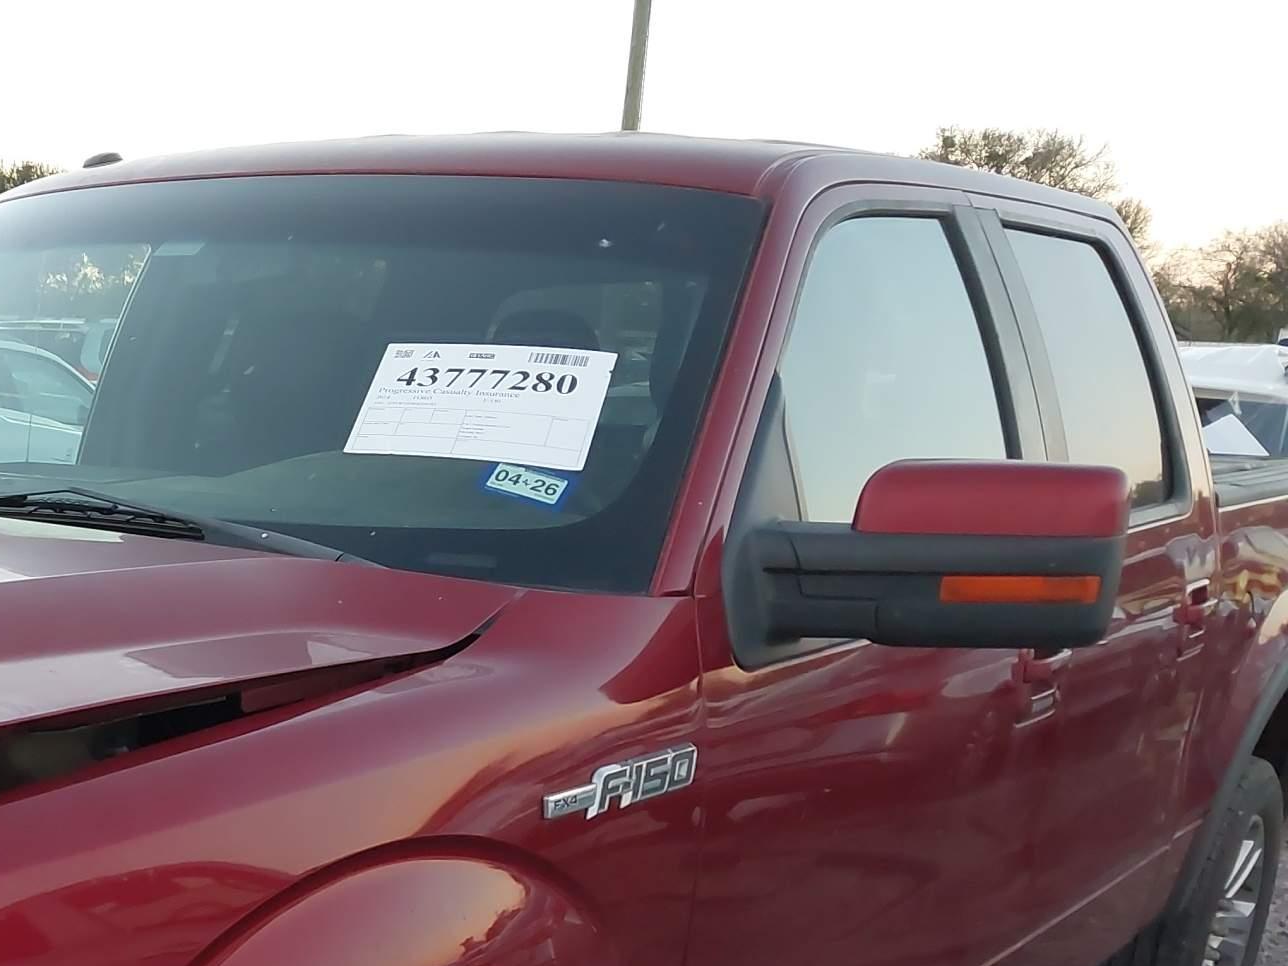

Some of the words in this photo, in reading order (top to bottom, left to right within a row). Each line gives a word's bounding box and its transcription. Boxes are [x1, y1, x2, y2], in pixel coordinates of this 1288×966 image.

[378, 387, 431, 396] Progressive
[432, 388, 472, 397] Casualty
[475, 389, 520, 399] Insurance
[396, 367, 578, 395] 43777280
[494, 468, 523, 487] 04
[529, 478, 560, 496] 26
